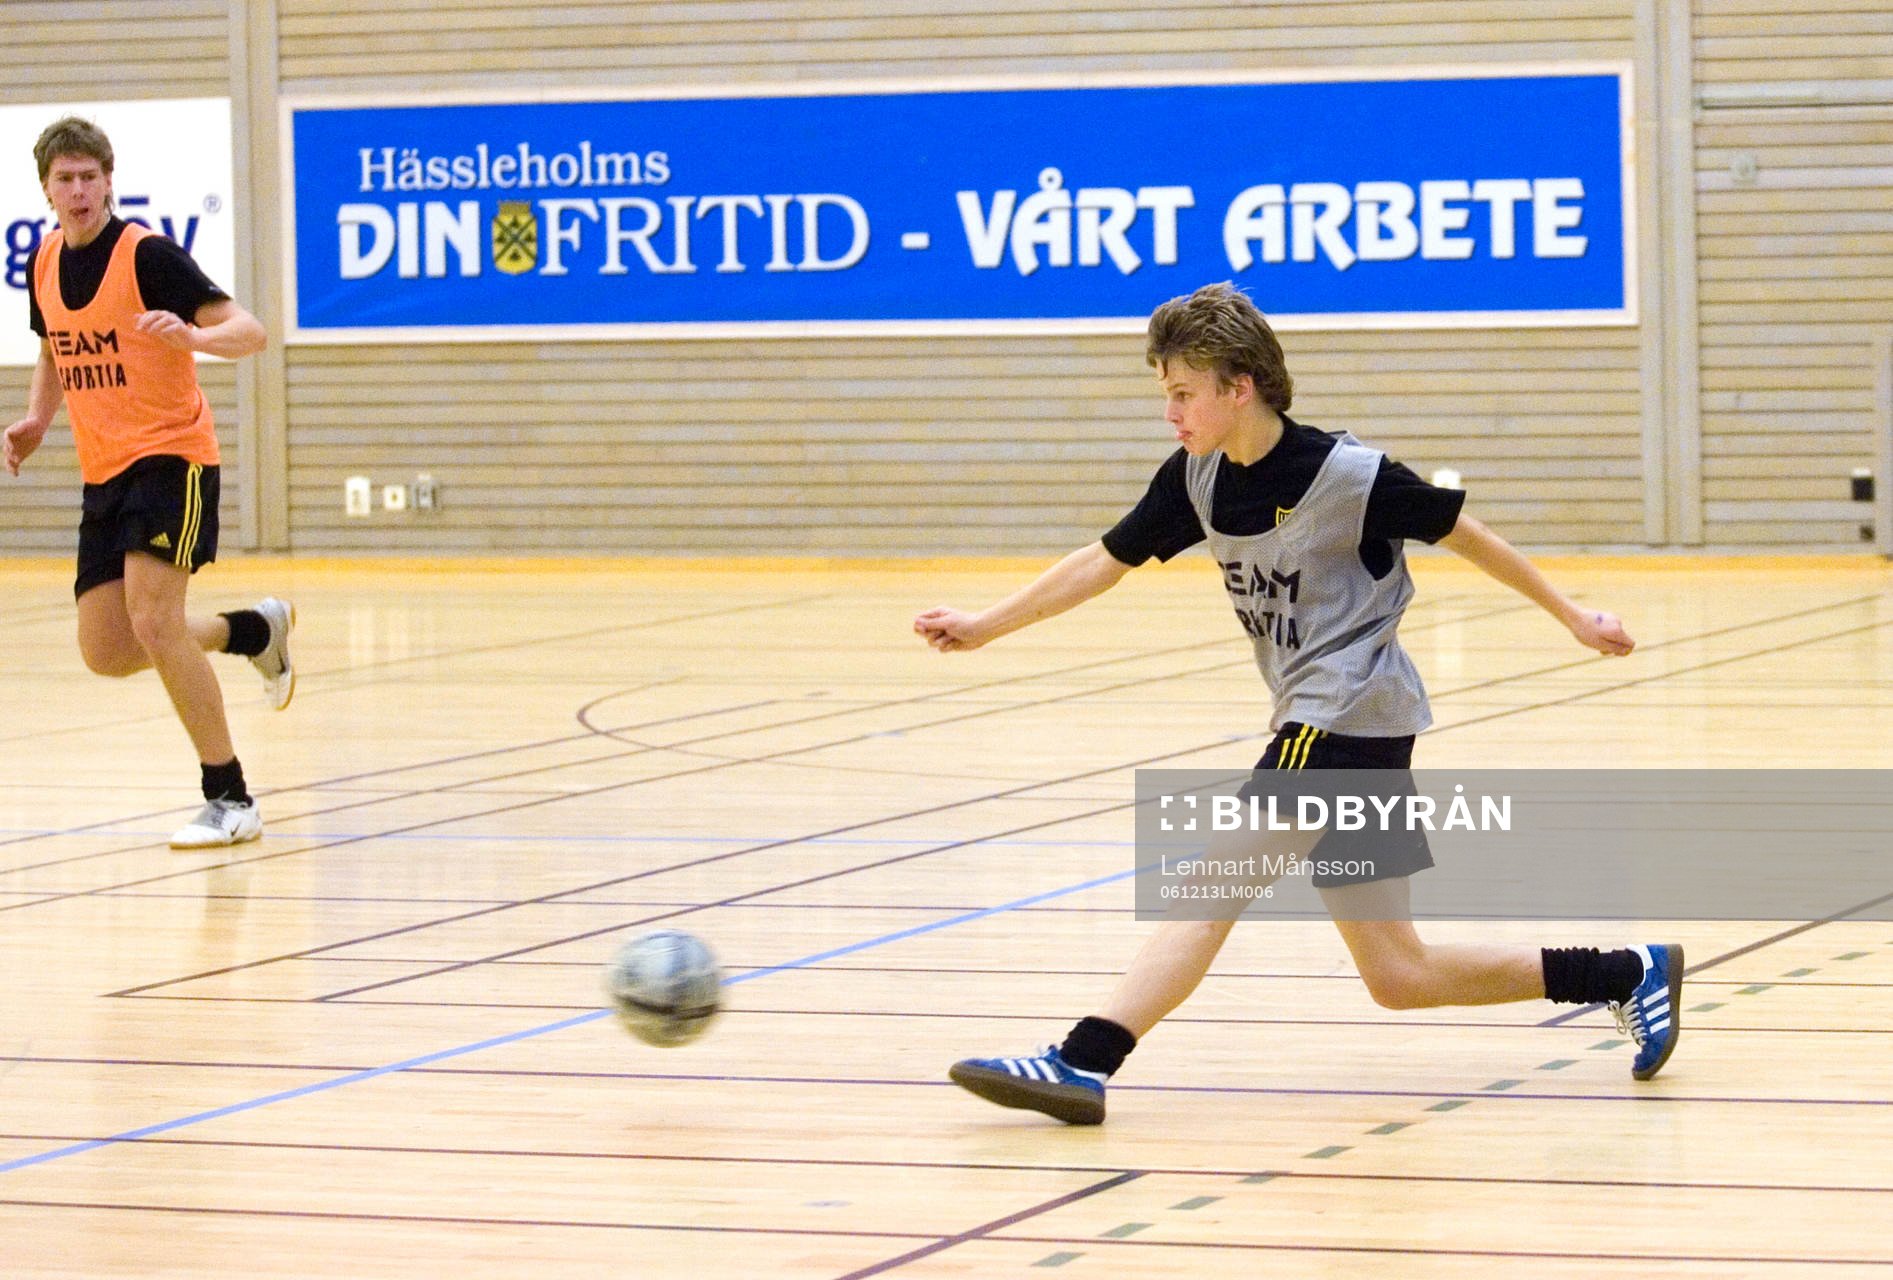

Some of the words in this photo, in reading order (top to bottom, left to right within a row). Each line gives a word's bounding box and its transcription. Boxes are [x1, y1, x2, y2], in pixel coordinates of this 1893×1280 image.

[358, 140, 671, 192] Hässleholms
[336, 200, 482, 280] DIN
[537, 192, 871, 277] FRITID
[955, 166, 1196, 277] VÅRT
[1222, 177, 1589, 273] ARBETE
[1218, 560, 1301, 604] EAM
